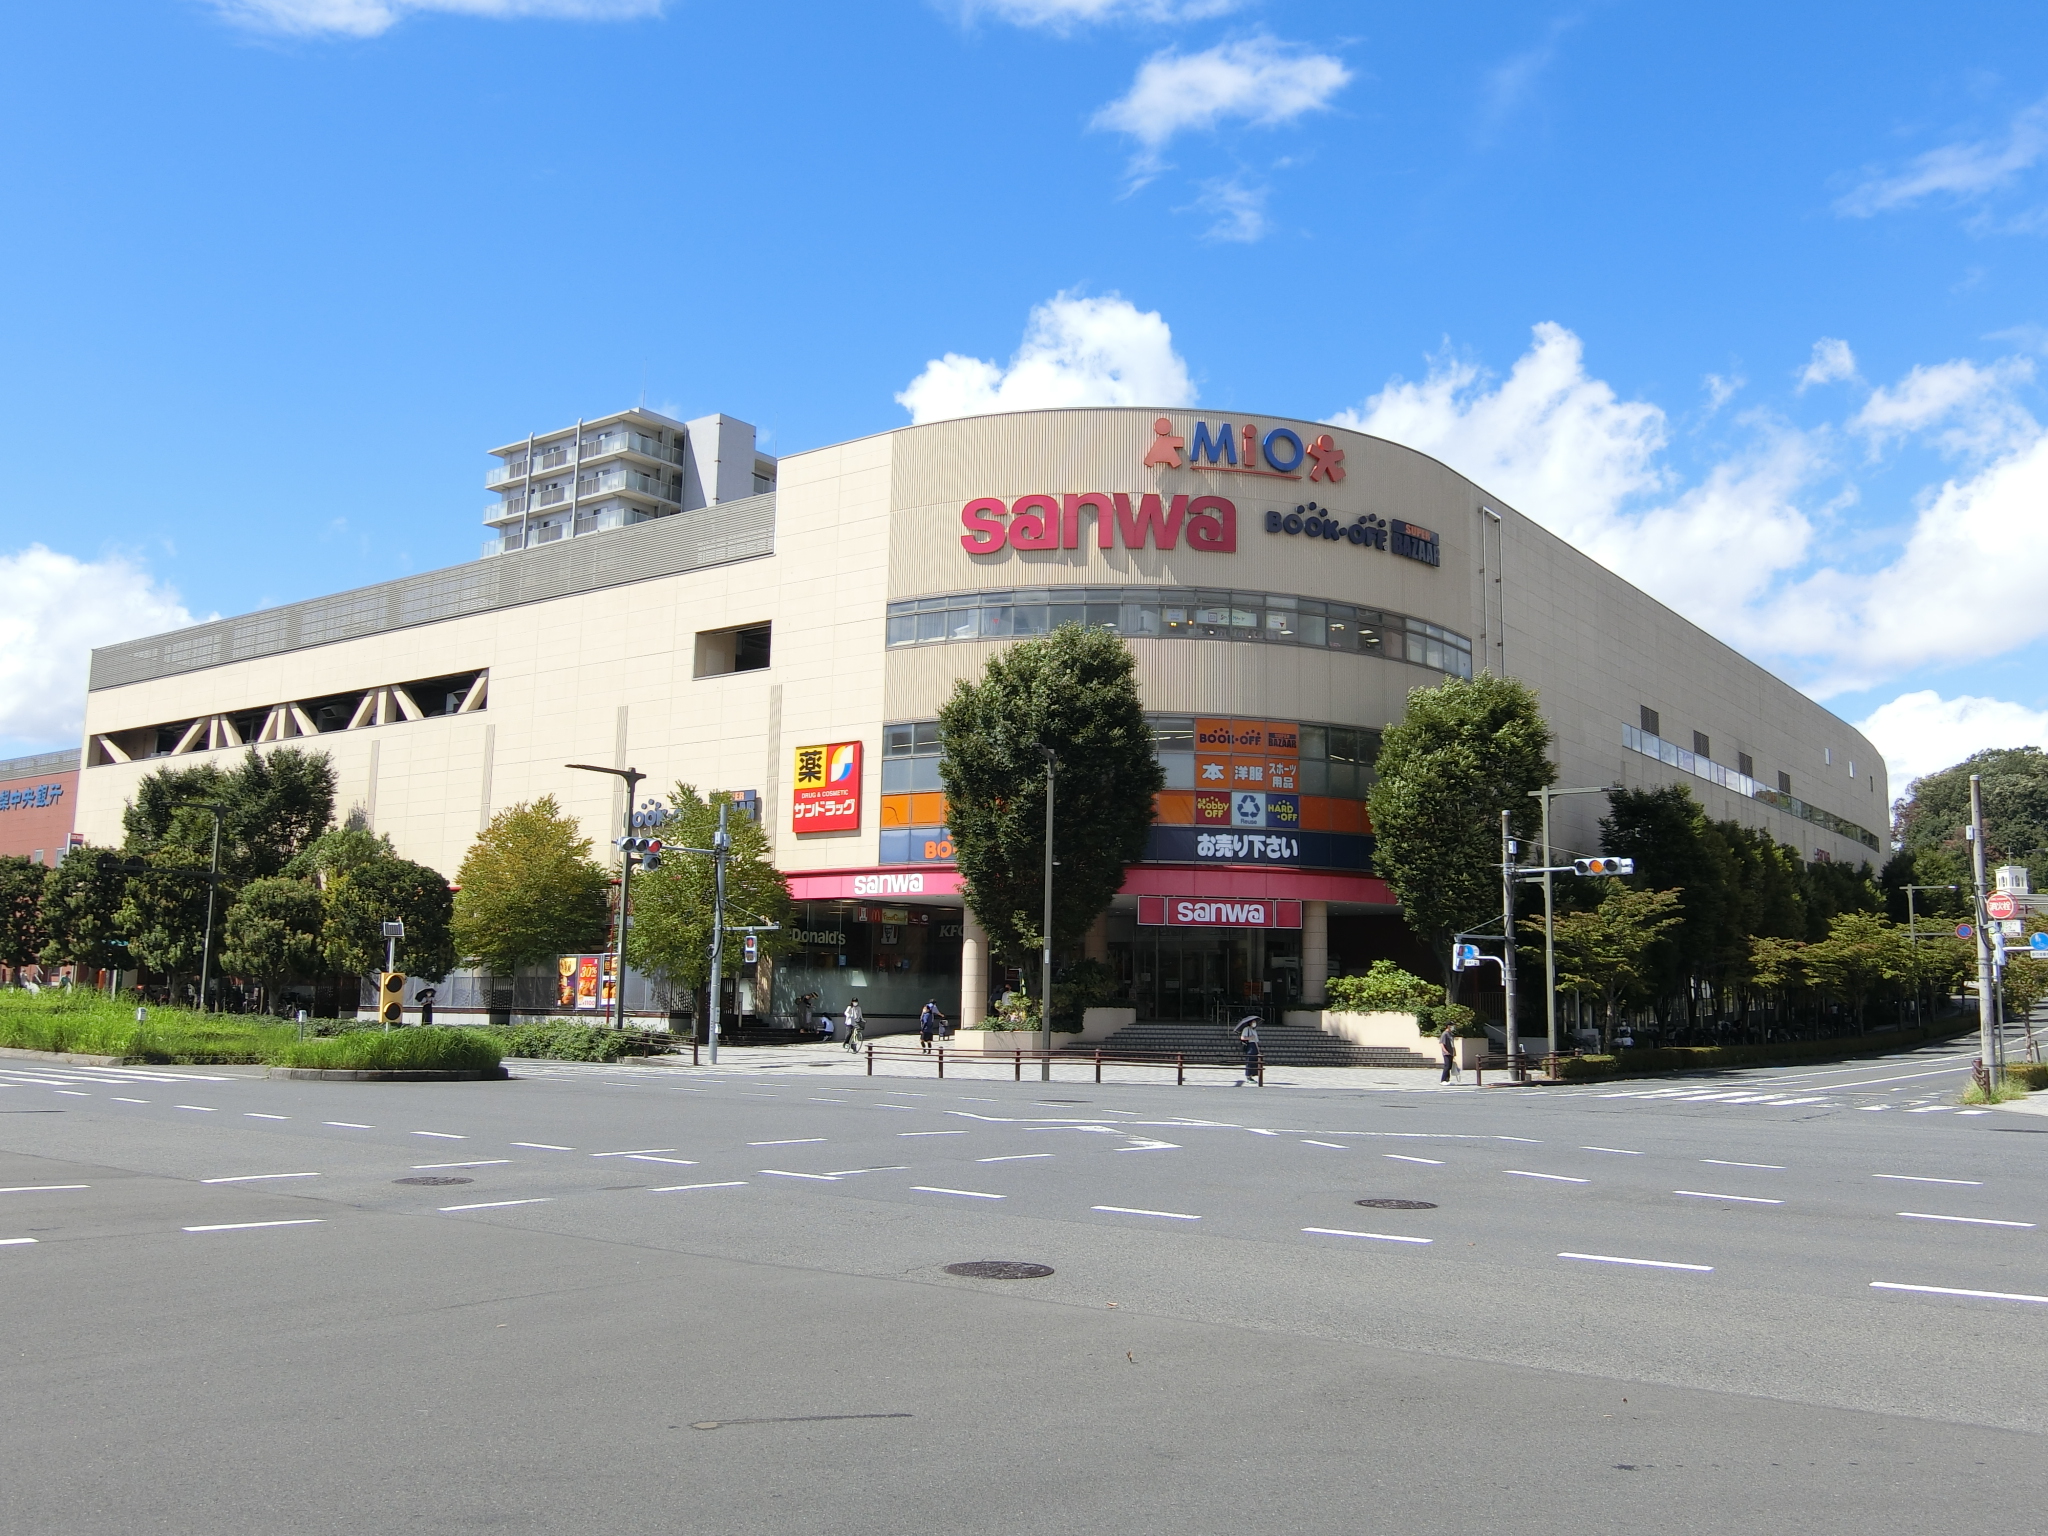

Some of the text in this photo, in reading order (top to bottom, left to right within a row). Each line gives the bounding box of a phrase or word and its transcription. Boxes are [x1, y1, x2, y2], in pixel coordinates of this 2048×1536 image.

[961, 492, 1237, 554] sanwa
[1405, 524, 1431, 541] SUPER
[1392, 532, 1440, 567] BAZAAR
[1268, 738, 1297, 749] BAZAAR
[798, 750, 823, 783] 薬
[1202, 762, 1263, 781] 本 洋服
[1268, 762, 1297, 776] スポーツ
[1272, 776, 1294, 789] 用品
[821, 789, 849, 797] COSMETIC
[794, 798, 856, 818] サンドラッグ
[1205, 809, 1224, 818] OFF
[1267, 803, 1294, 814] HARD
[1197, 833, 1299, 859] お売り下さい
[853, 873, 924, 895] sanwa
[1177, 902, 1265, 924] sanwa
[1989, 901, 2011, 911] 消火栓
